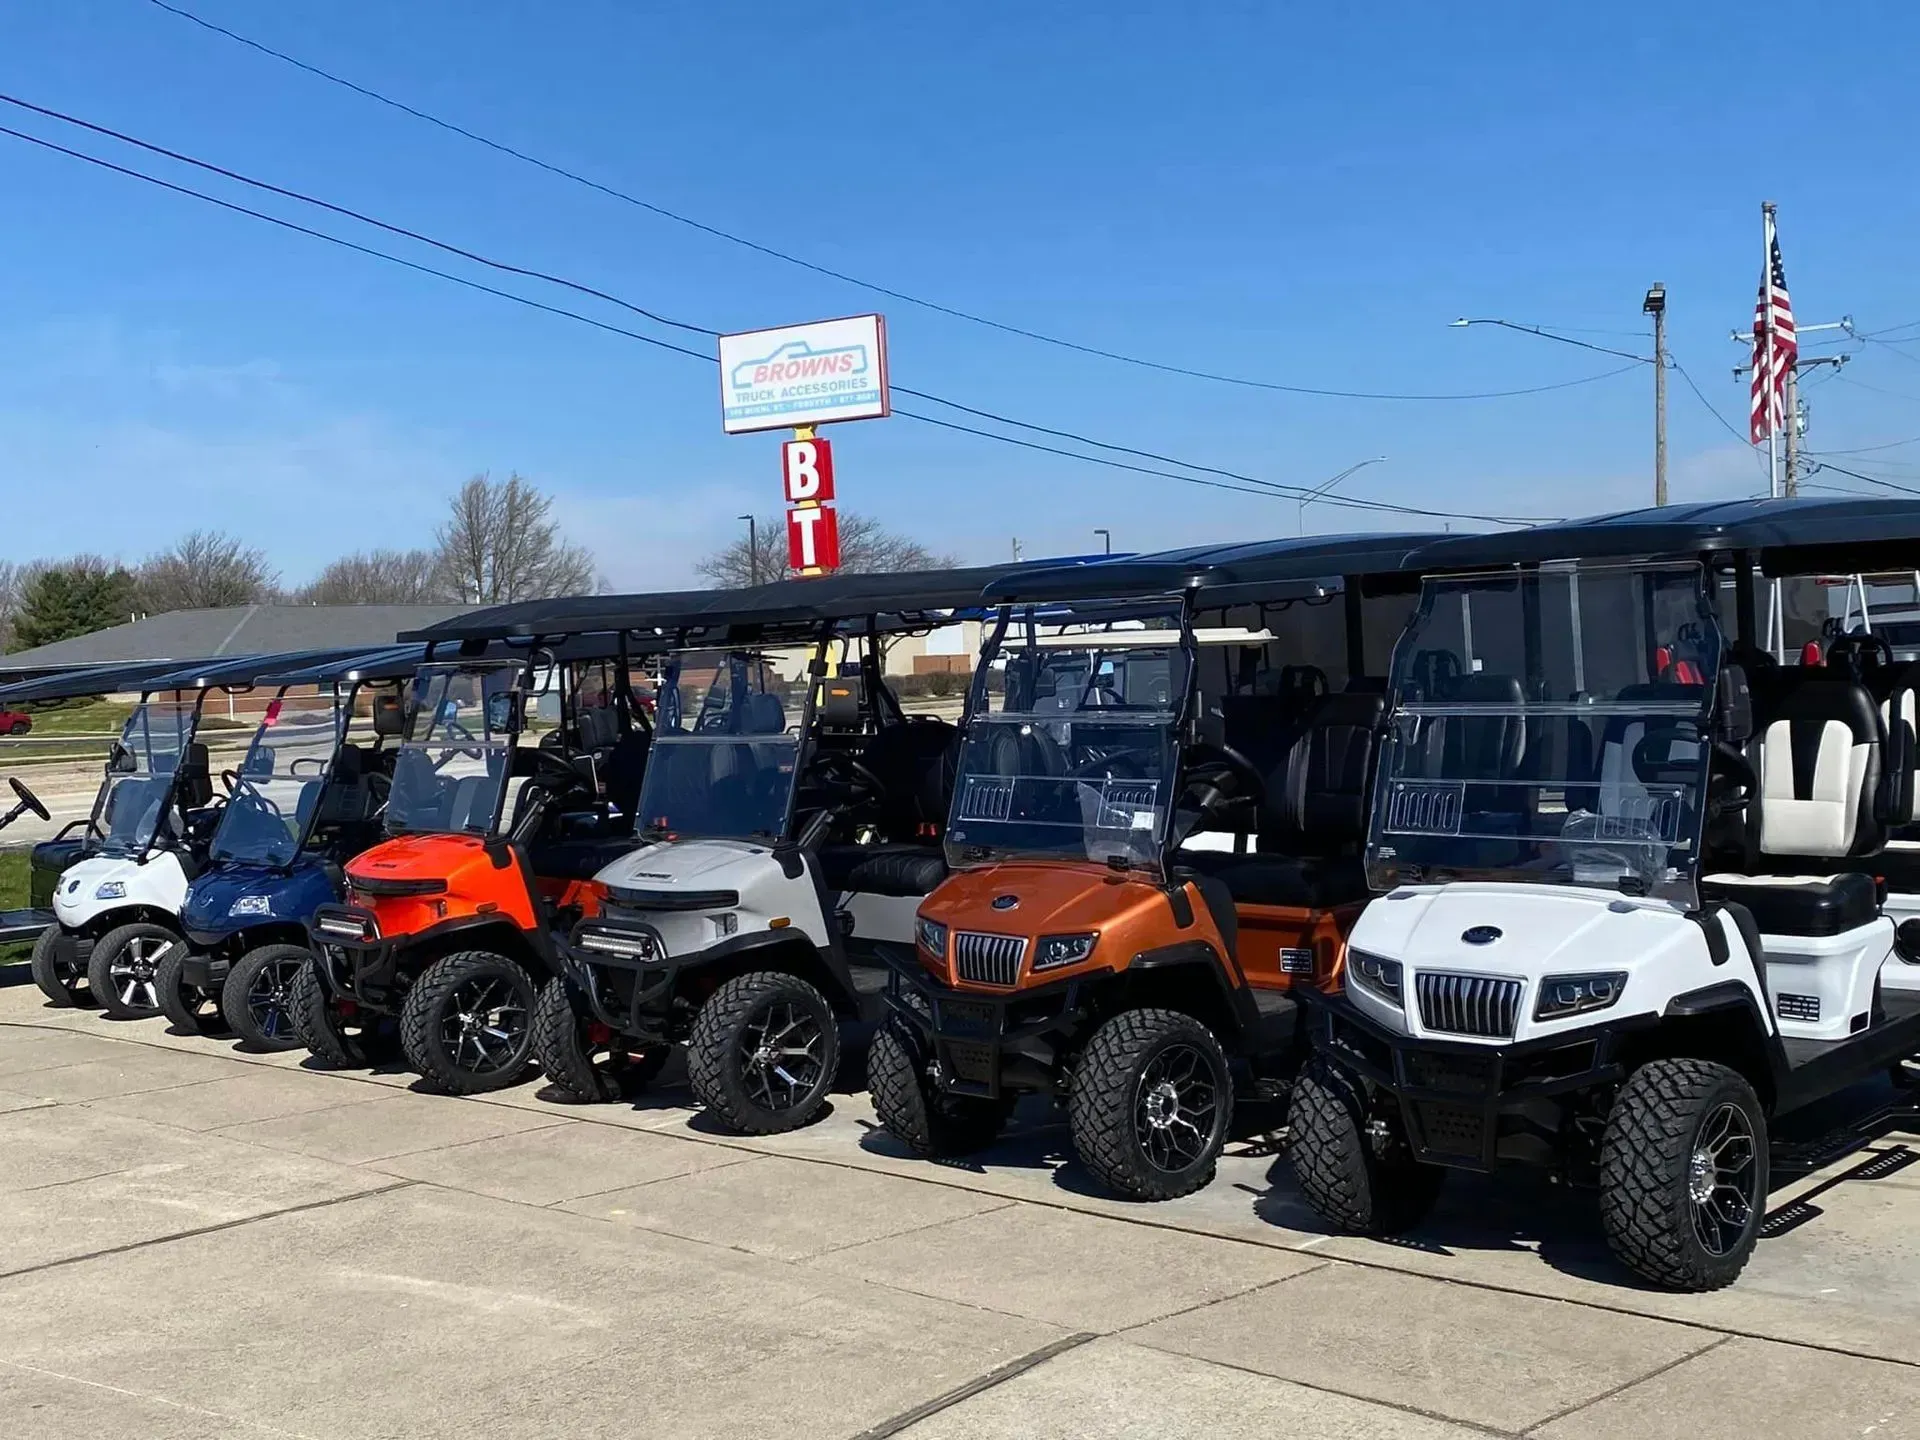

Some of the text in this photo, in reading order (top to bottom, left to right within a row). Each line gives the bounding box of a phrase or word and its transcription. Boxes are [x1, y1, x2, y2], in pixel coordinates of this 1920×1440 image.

[735, 377, 868, 403] TRUCK ACCESSORIES
[754, 354, 854, 384] BROWNS
[787, 441, 820, 500] B
[792, 507, 822, 566] T
